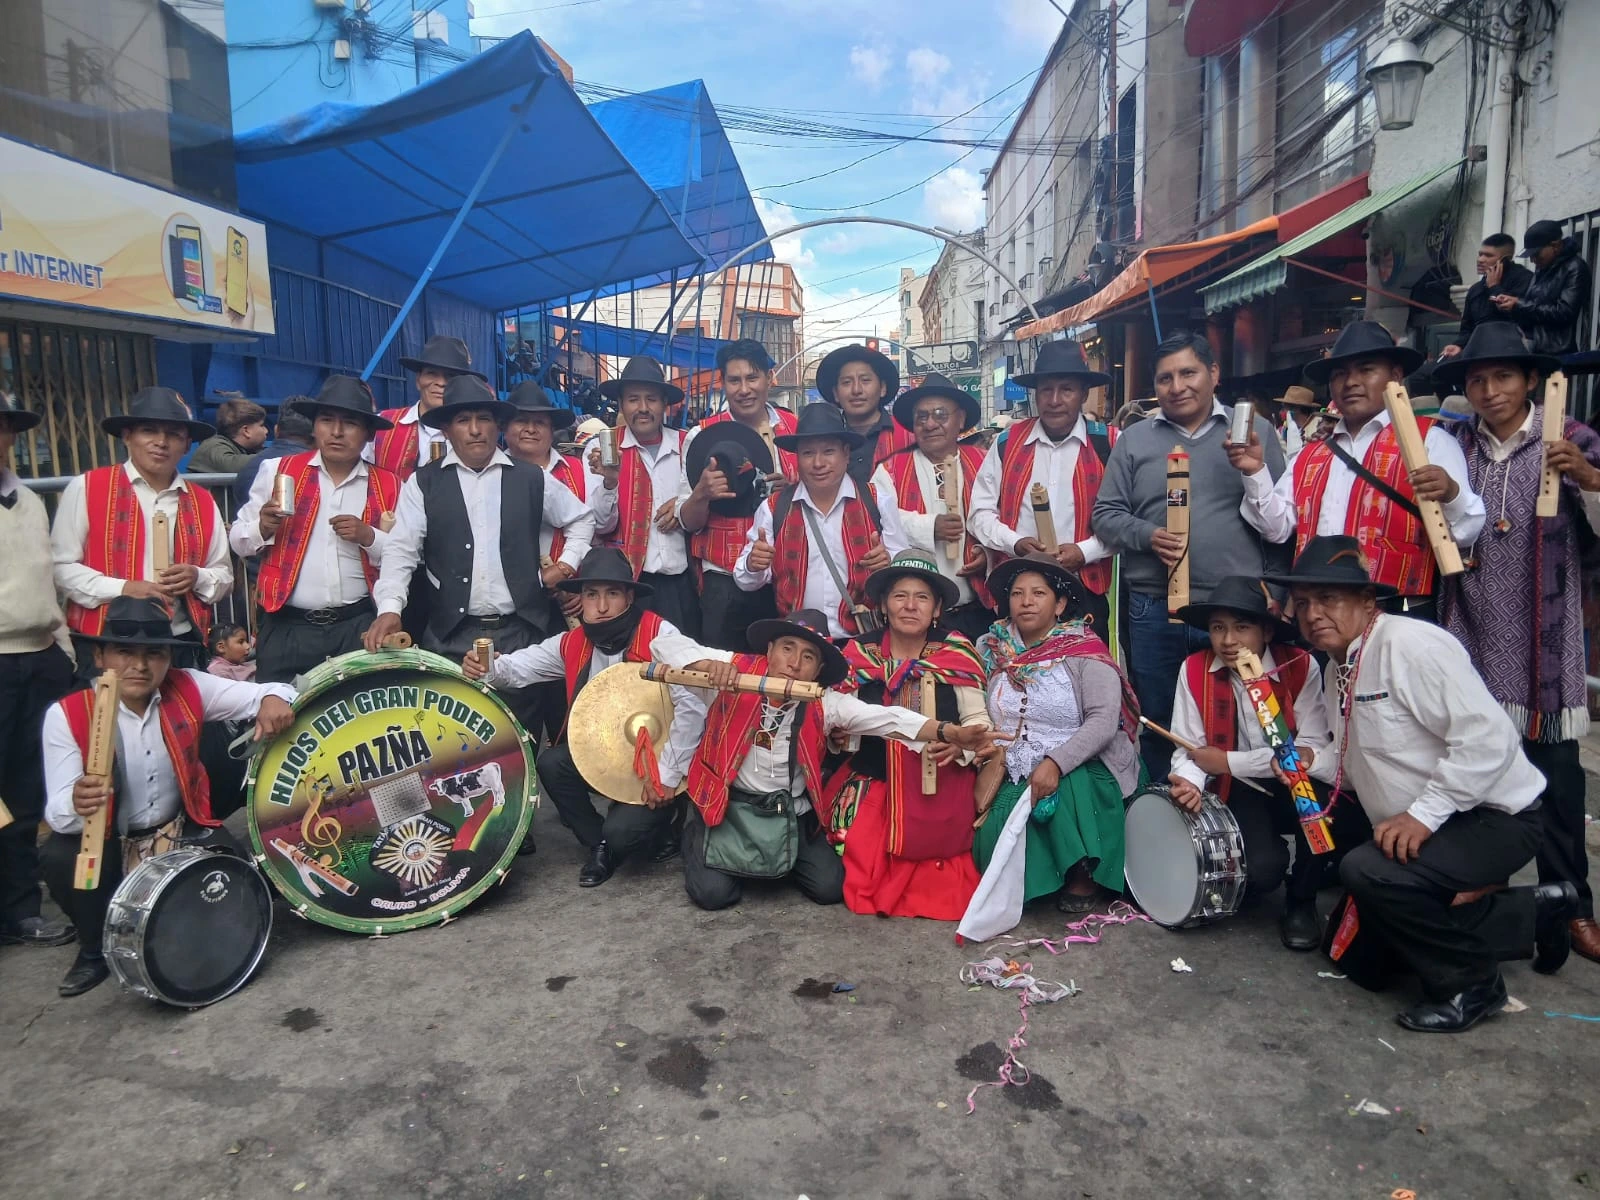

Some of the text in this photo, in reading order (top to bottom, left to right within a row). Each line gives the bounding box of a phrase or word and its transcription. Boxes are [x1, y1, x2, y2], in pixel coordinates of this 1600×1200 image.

[14, 249, 103, 288] INTERNET
[270, 686, 497, 806] HIJOS DEL GRAN PODER
[337, 725, 432, 785] PAZÑA
[371, 897, 417, 910] ORURO
[429, 867, 471, 902] BOLIVIA
